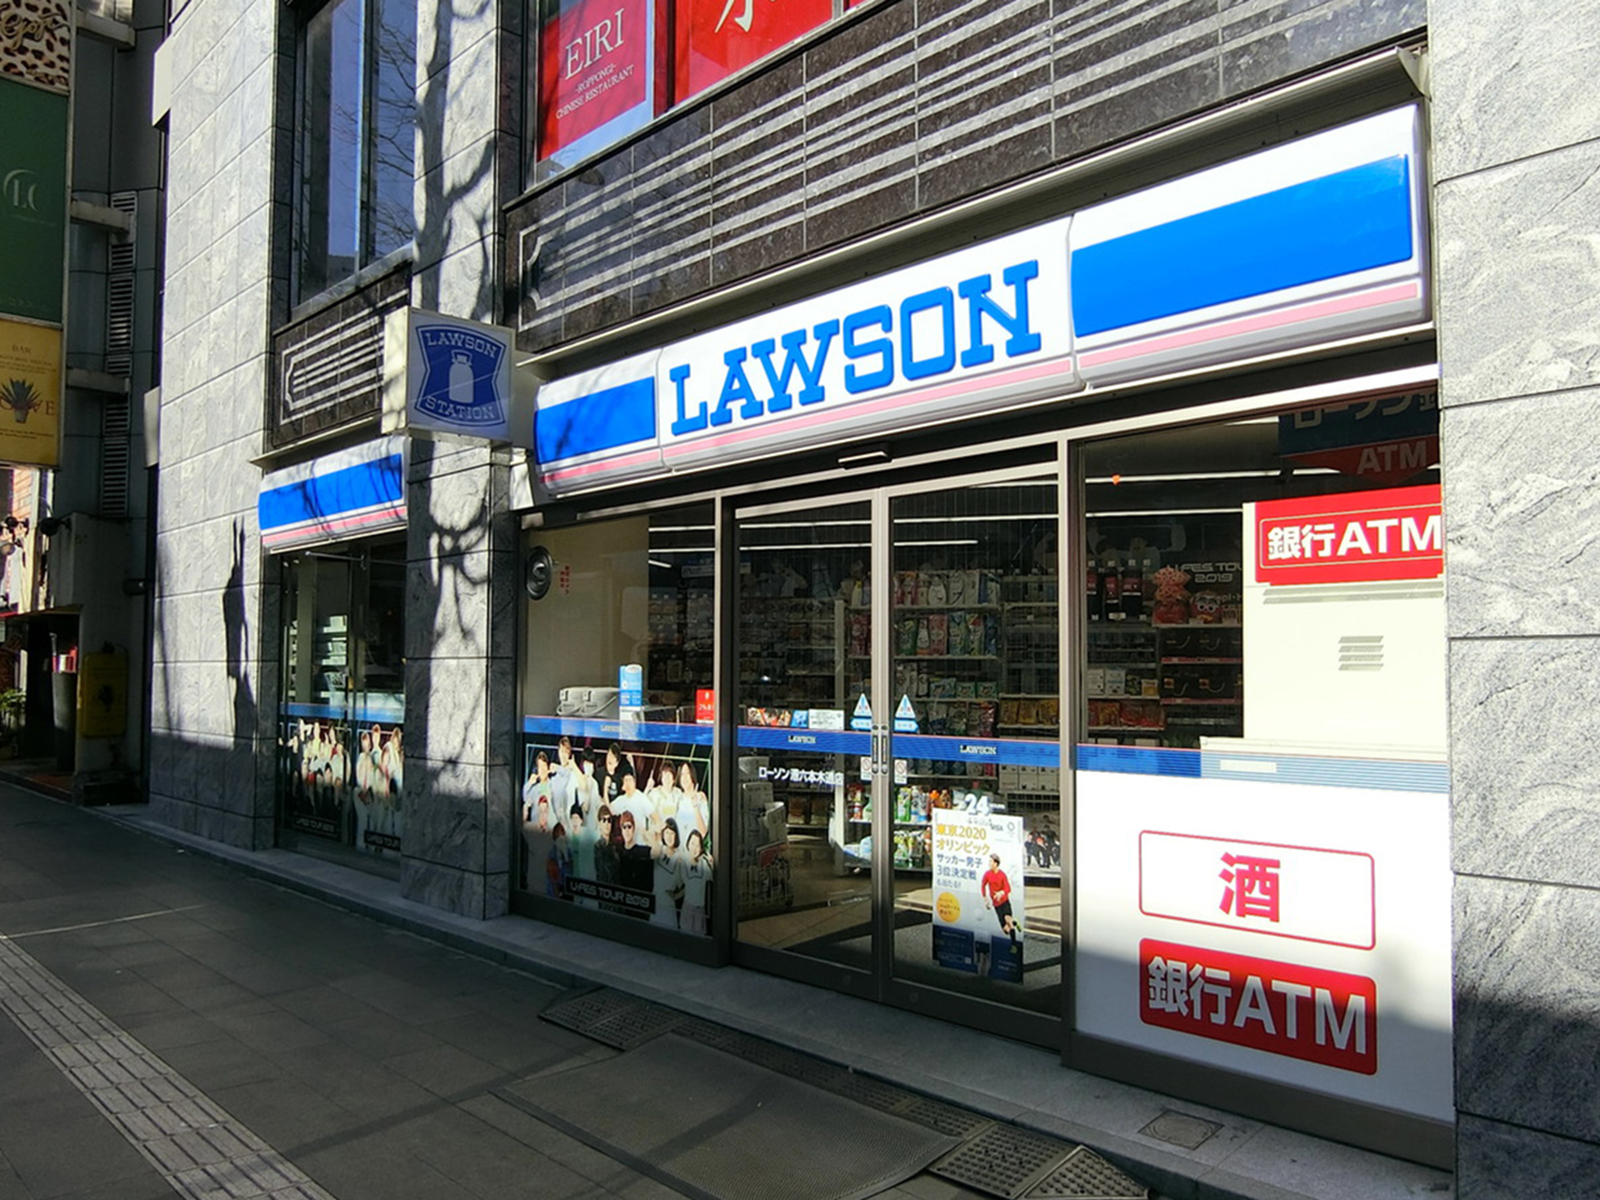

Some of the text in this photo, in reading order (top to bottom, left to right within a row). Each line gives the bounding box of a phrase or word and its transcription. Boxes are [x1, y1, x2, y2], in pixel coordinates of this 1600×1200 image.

[565, 7, 625, 80] EIRI
[585, 64, 634, 102] RESTAURANT
[425, 332, 498, 358] LAWSON
[669, 259, 1042, 436] LAWSON
[424, 395, 495, 419] STATION
[1356, 440, 1428, 475] ATM
[1267, 514, 1442, 560] 銀行ATM
[1195, 573, 1233, 583] 2019
[936, 823, 987, 840] 東京2020
[936, 838, 990, 855] オリンピック
[936, 853, 982, 868] サッカー男子
[598, 887, 625, 903] TOUR
[1218, 851, 1281, 923] 酒
[1147, 955, 1367, 1055] 銀行ATM
